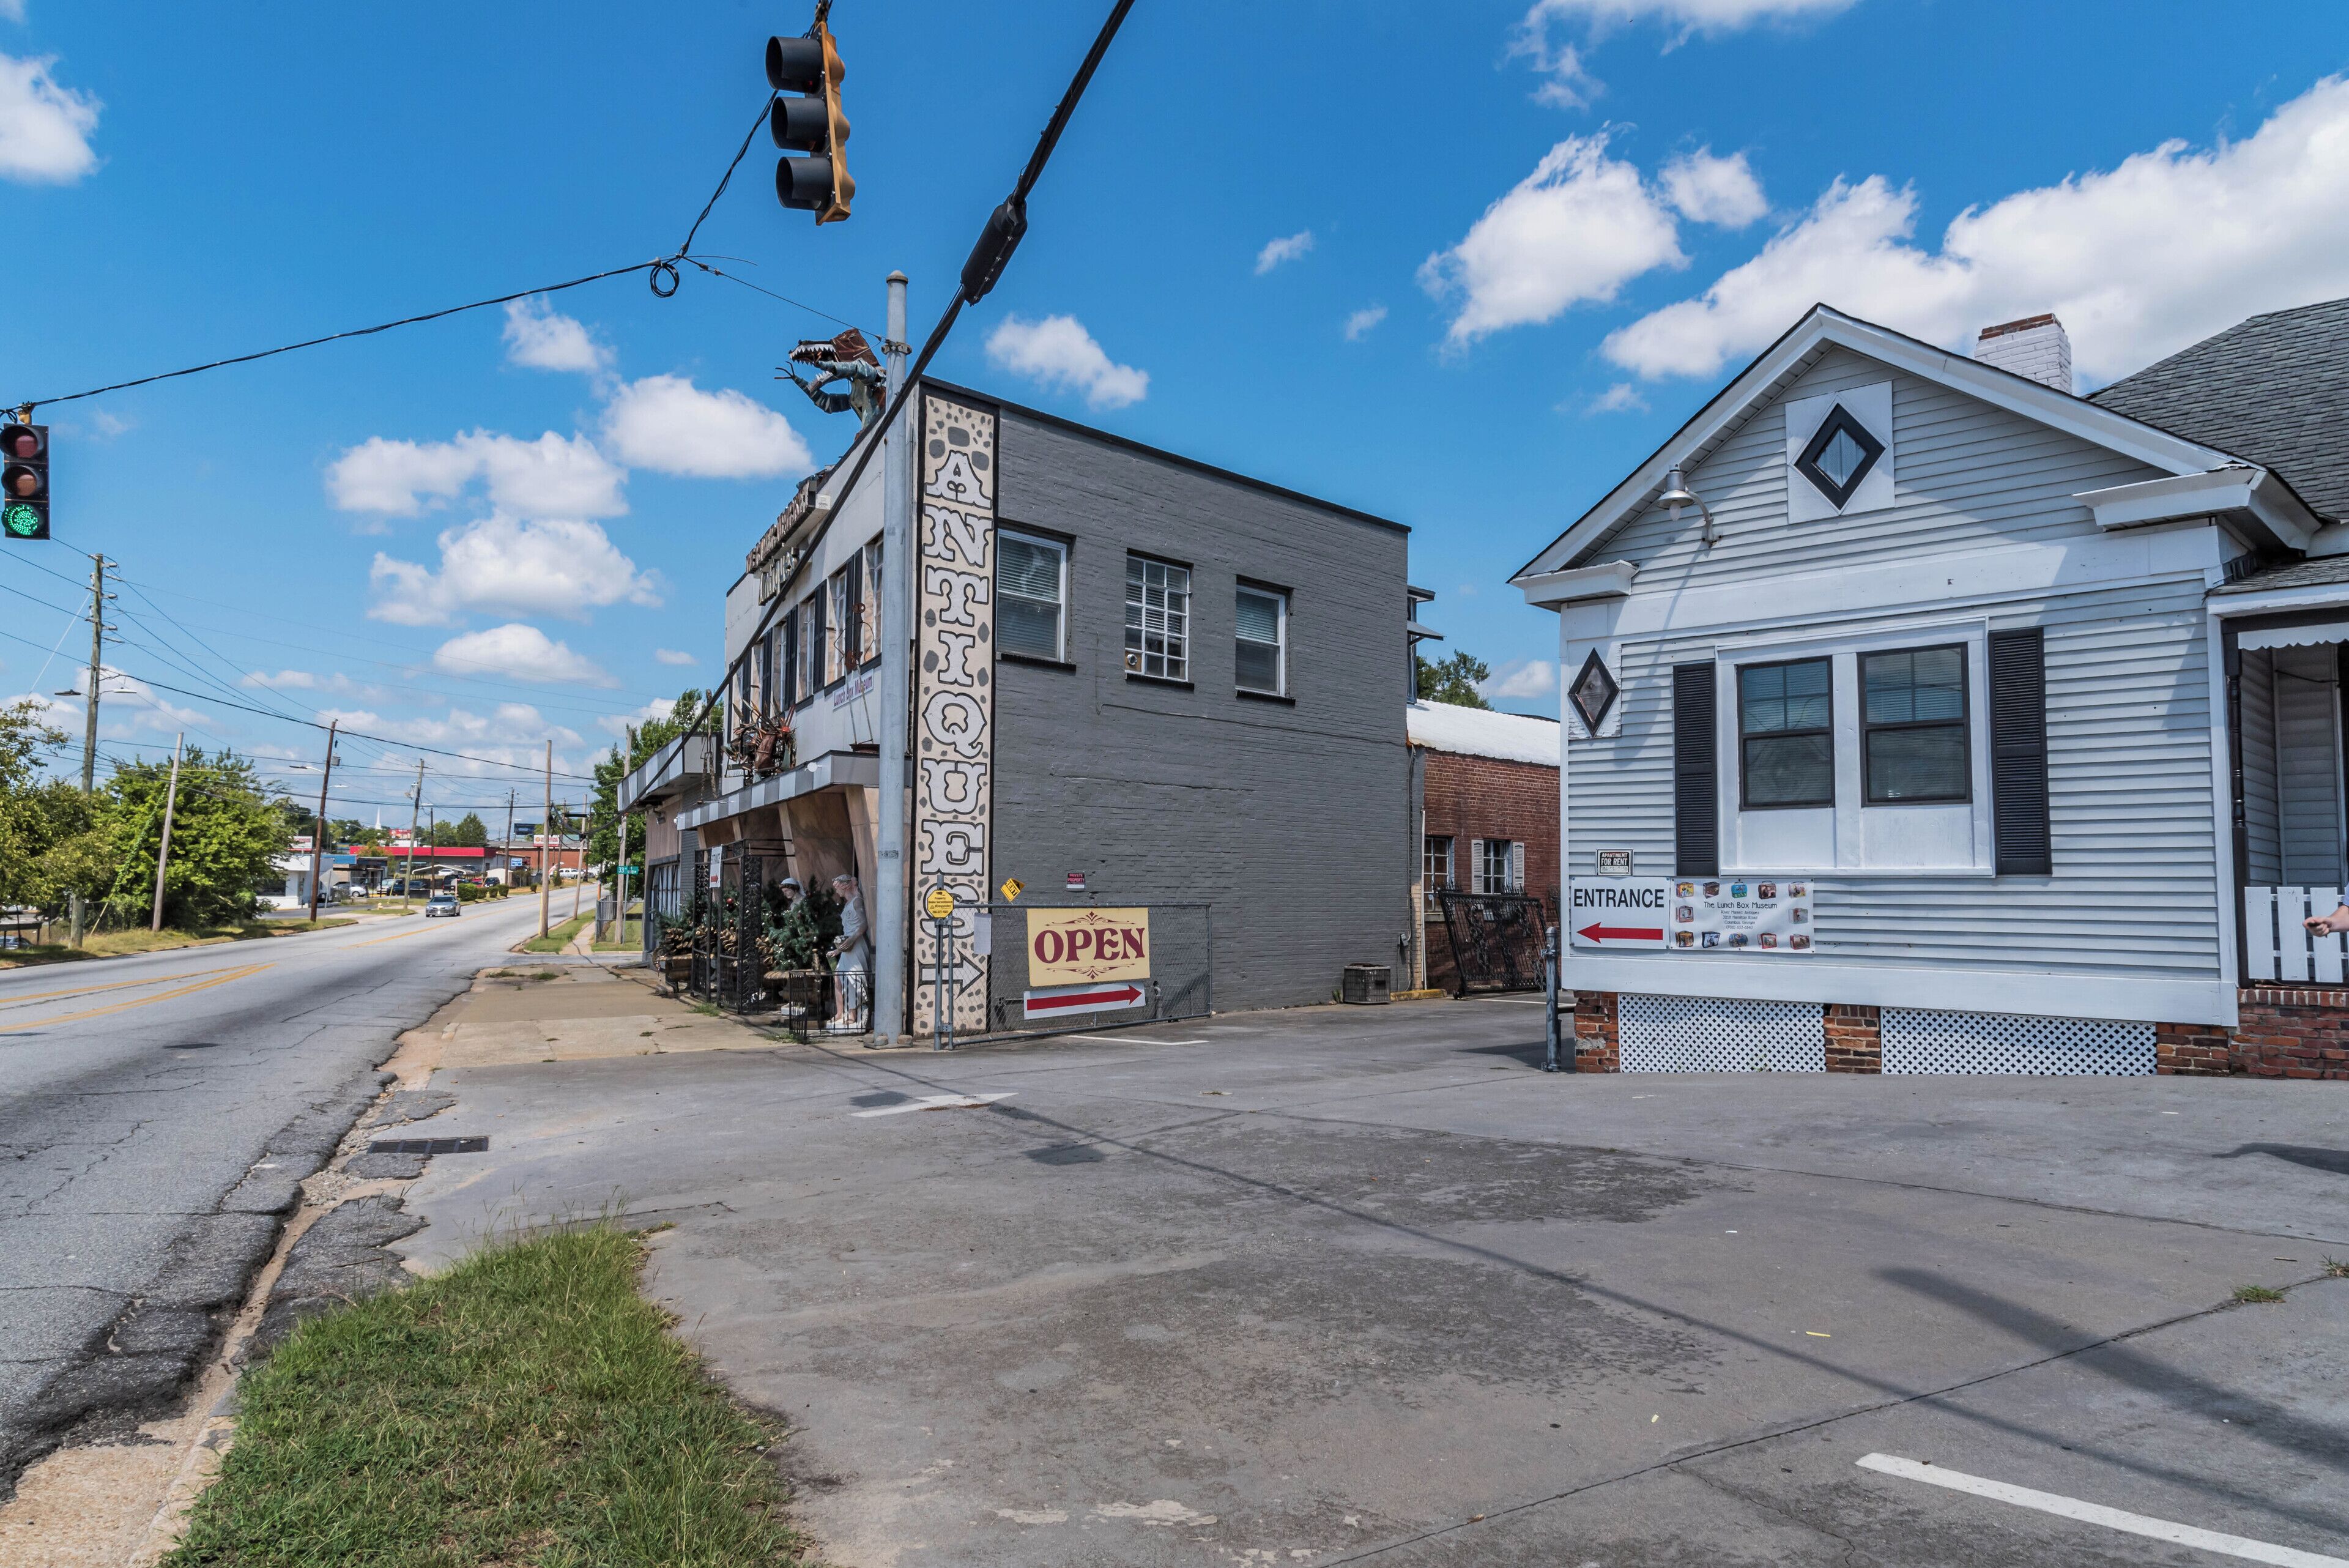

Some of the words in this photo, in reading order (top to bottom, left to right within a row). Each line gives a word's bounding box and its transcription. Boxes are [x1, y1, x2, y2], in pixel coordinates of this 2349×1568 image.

[920, 450, 994, 938] ANTIQUES
[1574, 888, 1664, 908] ENTRANCE
[1034, 927, 1146, 964] OPEN
